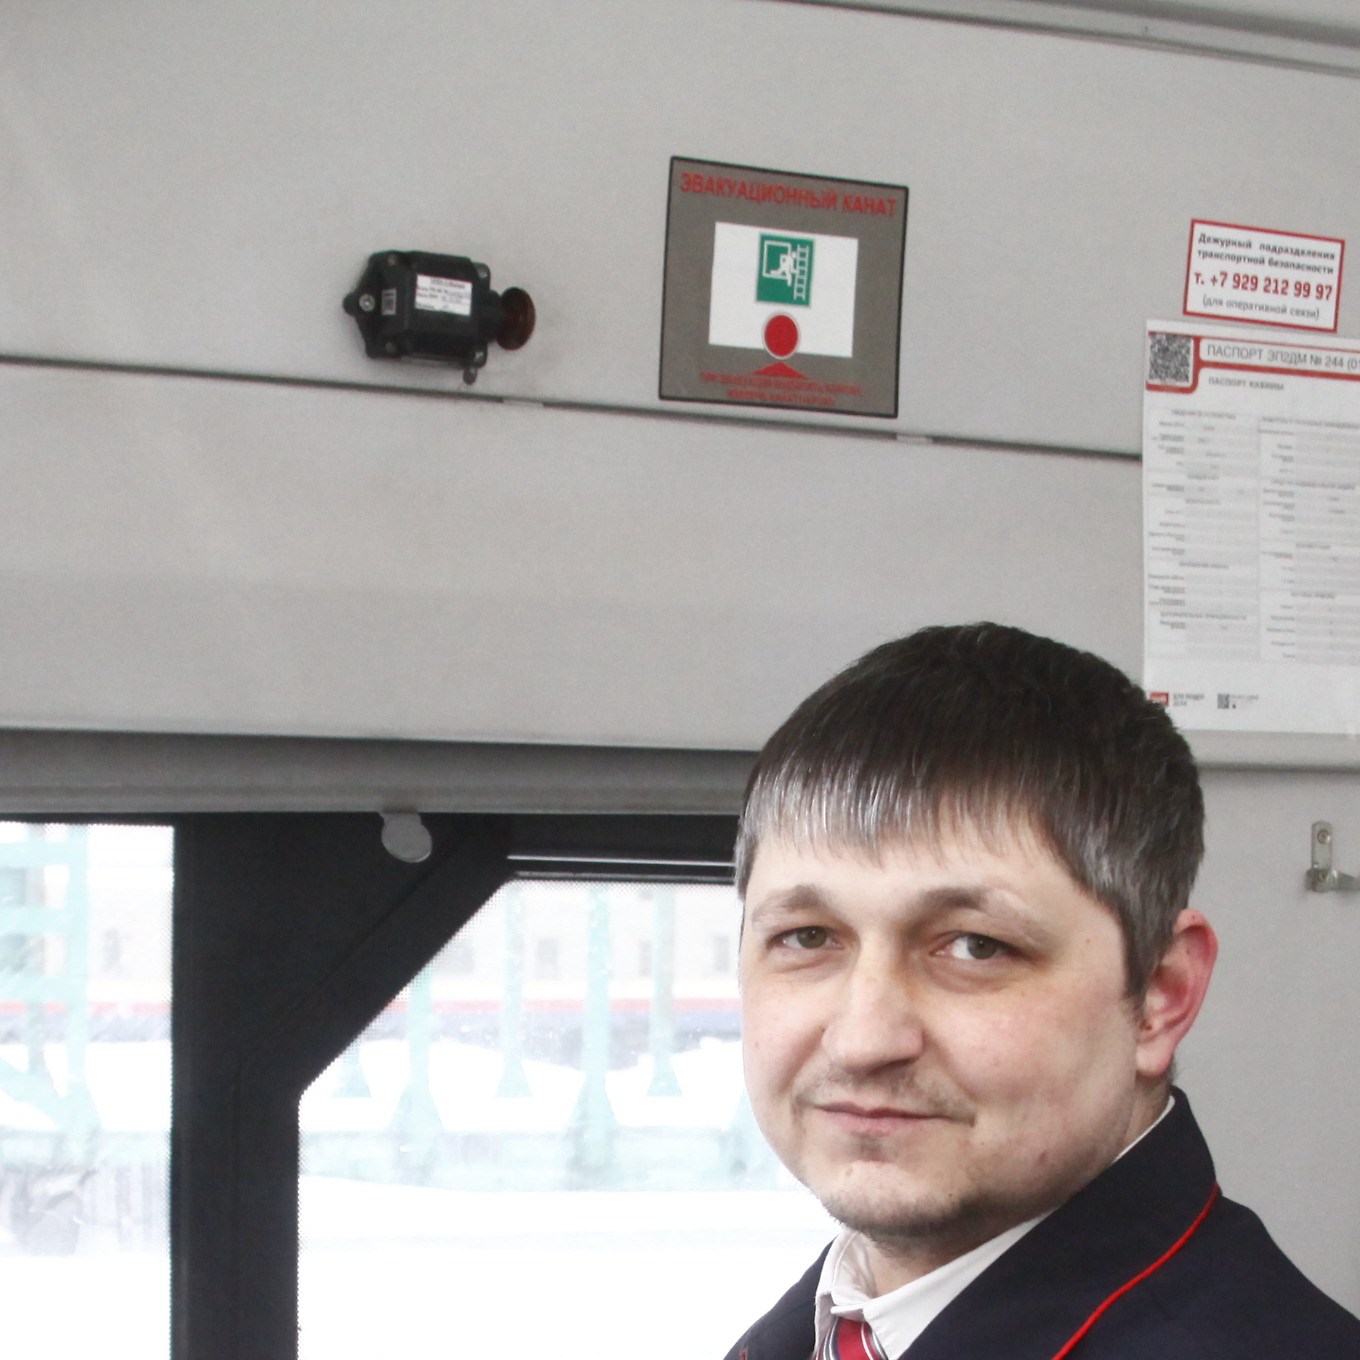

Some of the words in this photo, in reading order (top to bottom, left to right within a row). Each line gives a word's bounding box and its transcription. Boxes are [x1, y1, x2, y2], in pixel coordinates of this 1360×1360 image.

[679, 172, 838, 210] ЭВАКУАЦИОННЫЙ
[842, 194, 897, 217] КАНАТ
[1198, 233, 1253, 249] Дежурный
[1259, 243, 1335, 261] подразделения
[1197, 249, 1266, 265] транспортной
[1268, 256, 1334, 274] безопасности
[1210, 271, 1228, 288] +7
[1232, 273, 1259, 292] 929
[1263, 277, 1289, 296] 212
[1293, 280, 1311, 299] 99
[1315, 284, 1333, 302] 97
[1207, 343, 1263, 361] ПАСПОРТ
[1267, 349, 1307, 366] ЭП2ДМ
